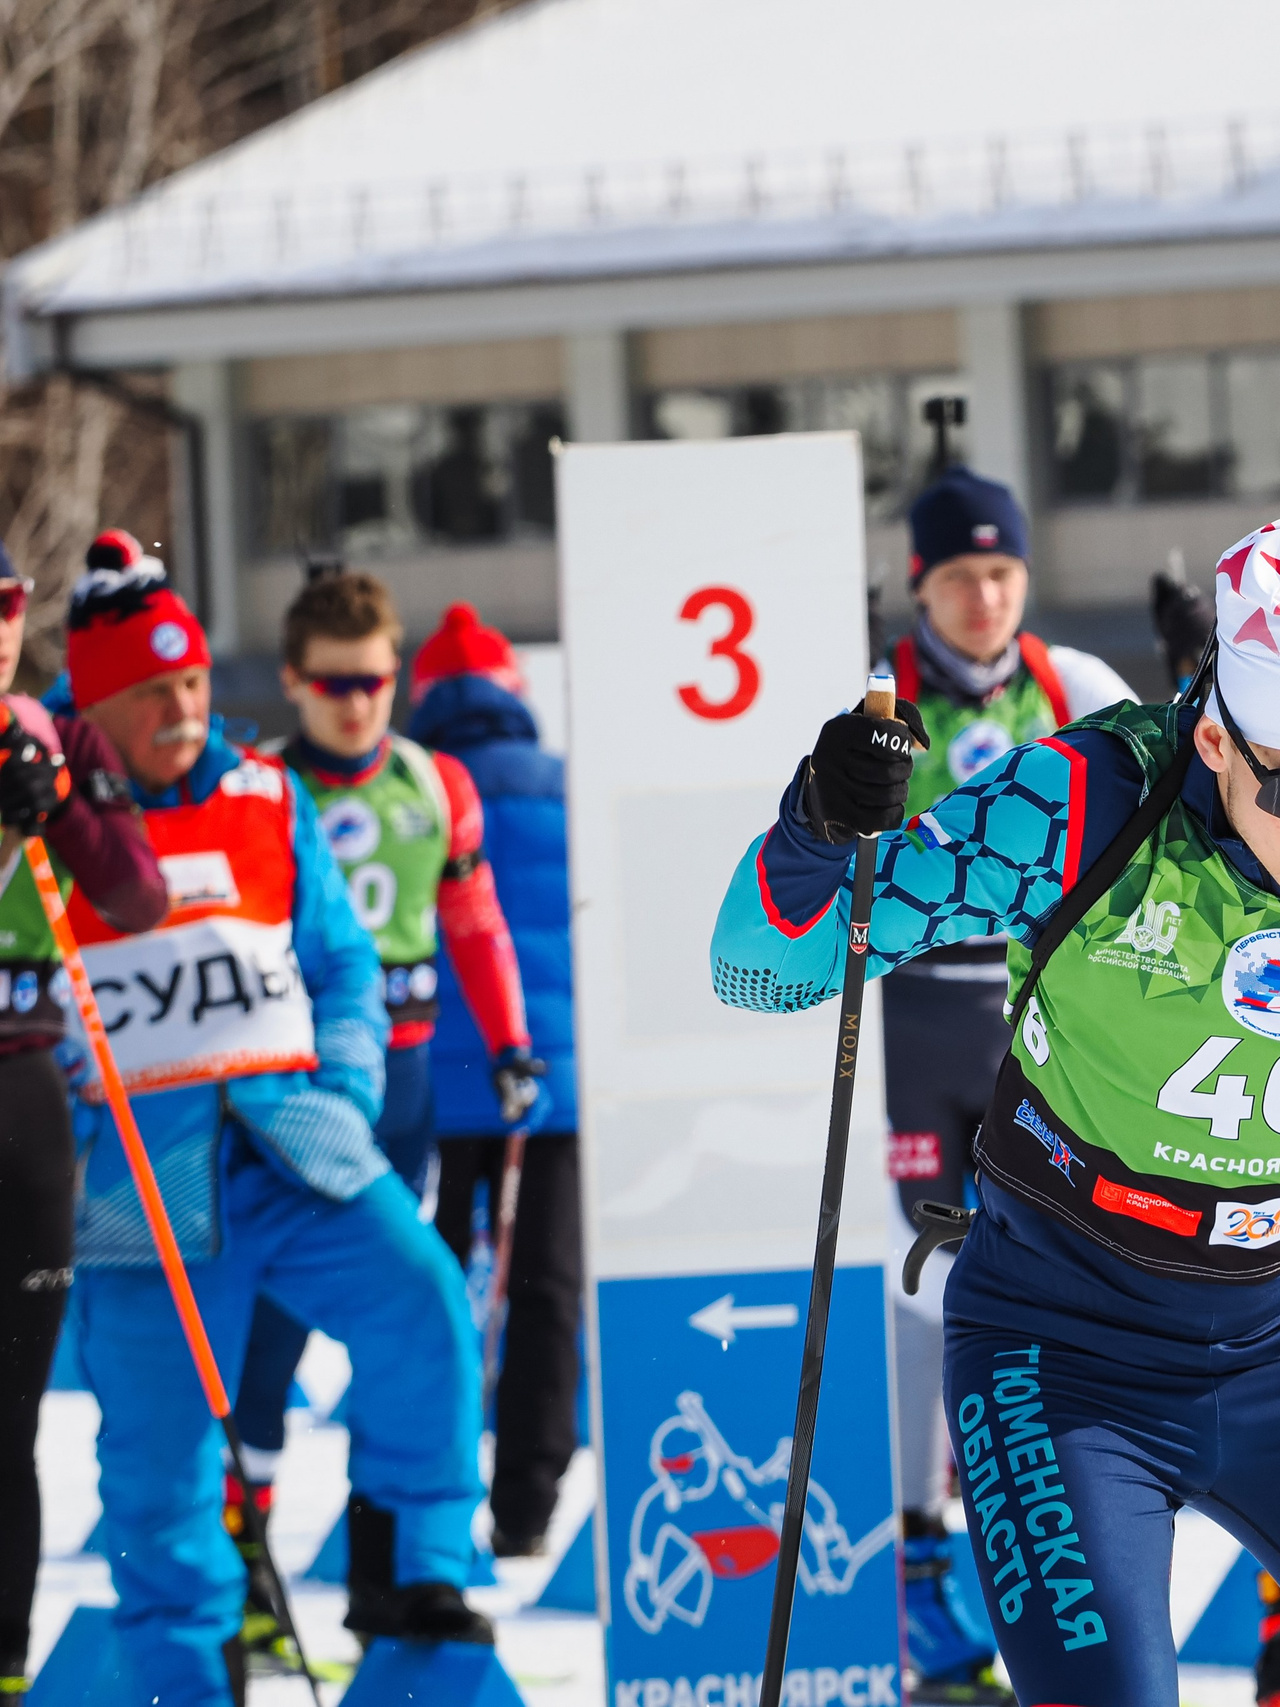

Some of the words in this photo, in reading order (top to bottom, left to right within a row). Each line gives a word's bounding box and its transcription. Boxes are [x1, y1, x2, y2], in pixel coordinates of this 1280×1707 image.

[677, 584, 762, 721] 3
[871, 729, 910, 756] MOA
[92, 950, 303, 1033] СУДЬ
[1088, 953, 1139, 969] РОССИЙСКОЙ
[1140, 963, 1190, 981] ФЕДЕРАЦИИ
[1158, 959, 1189, 973] СПОРТА
[838, 1013, 859, 1078] MOAX
[1125, 1198, 1149, 1211] КРАЙ
[958, 1393, 1032, 1625] ОБЛАСТЬ
[993, 1344, 1108, 1652] ТЮМЕНСКАЯ
[614, 1663, 898, 1707] КРАСНЯРСК
